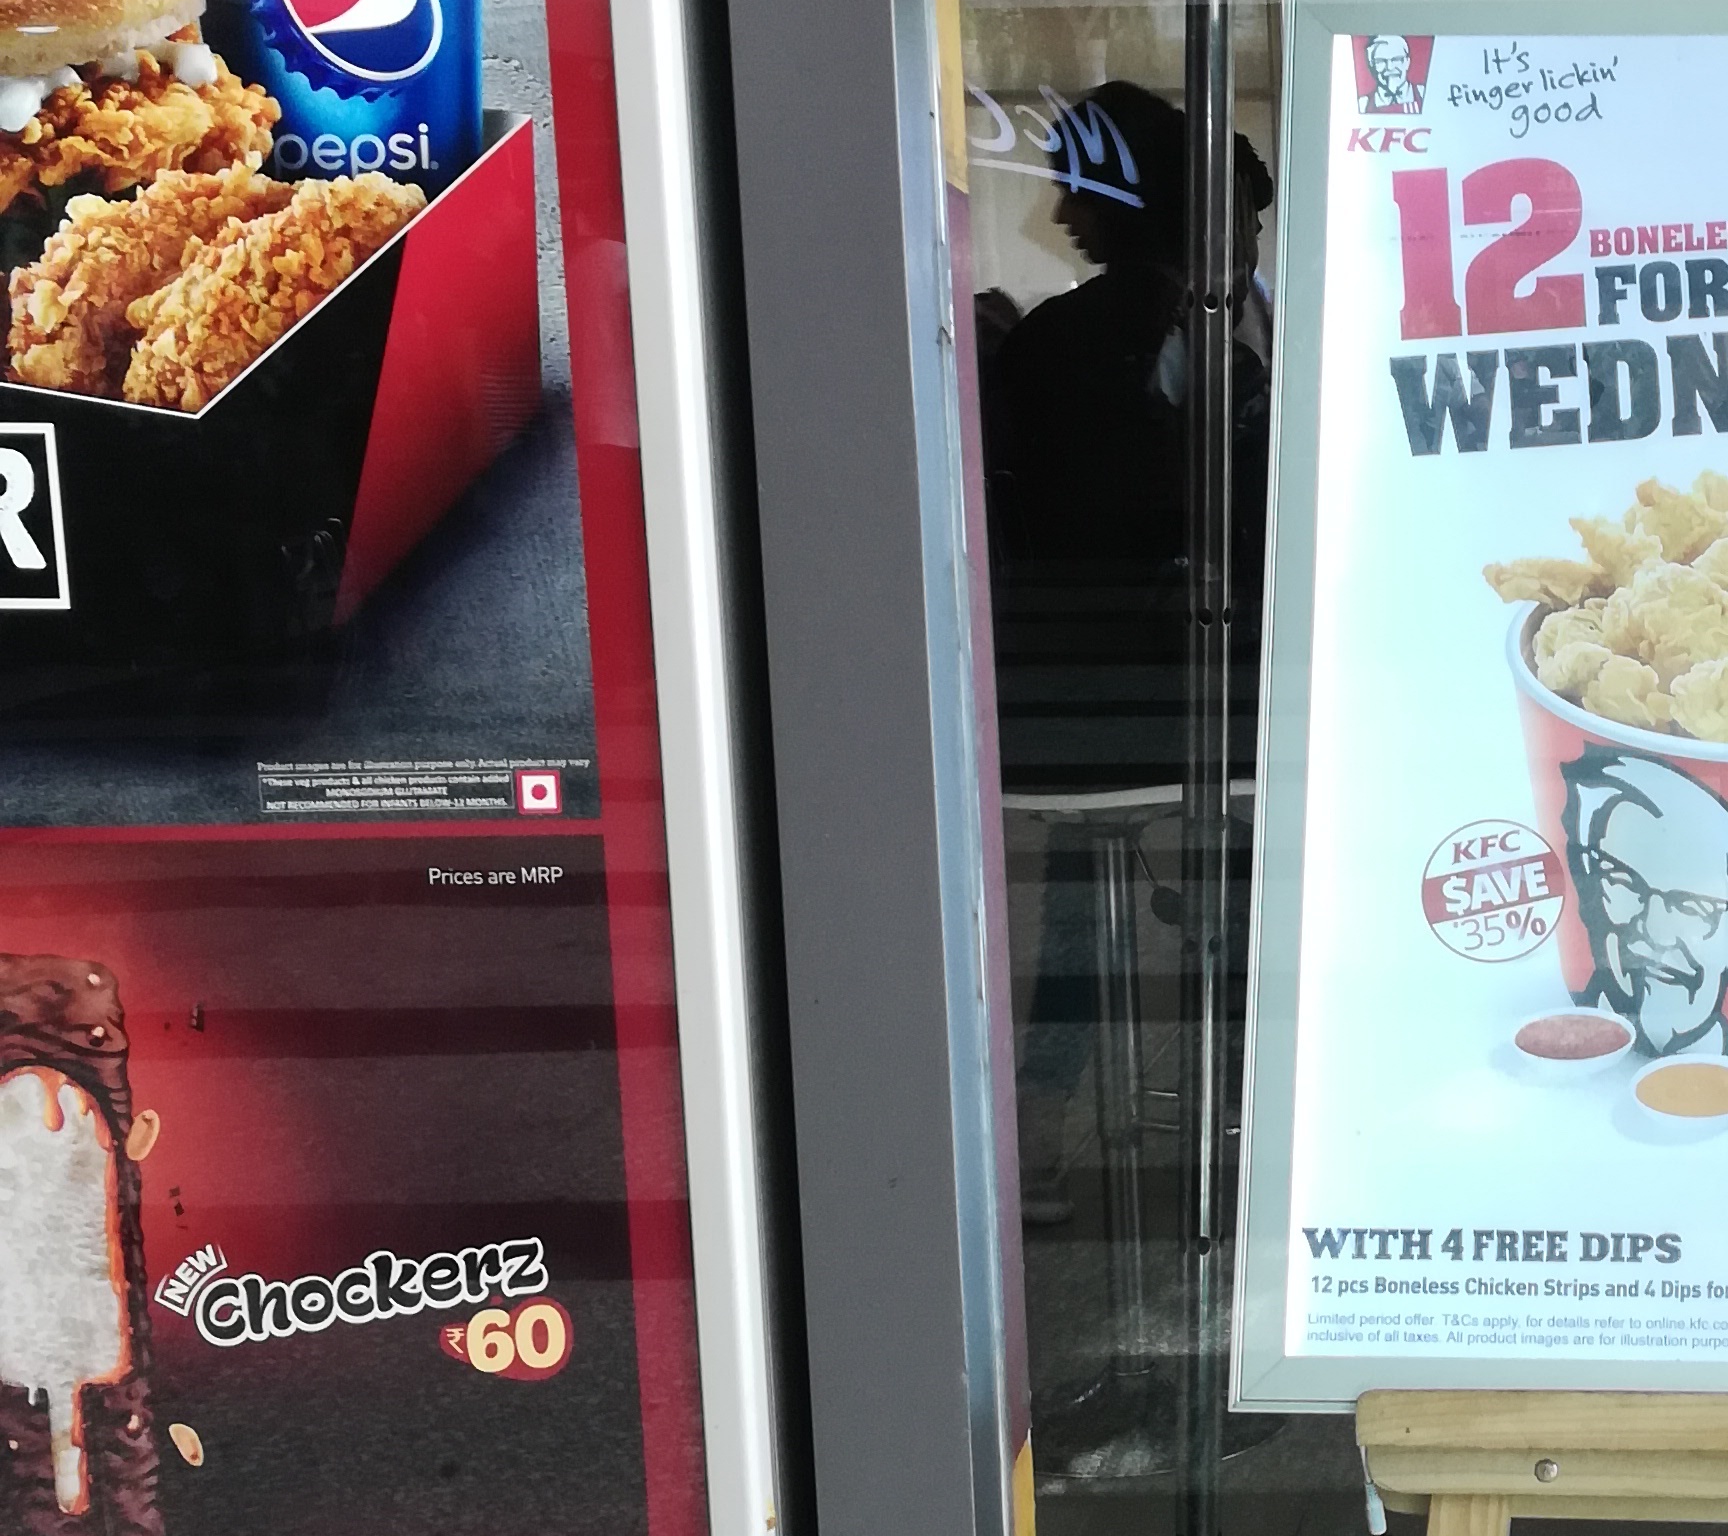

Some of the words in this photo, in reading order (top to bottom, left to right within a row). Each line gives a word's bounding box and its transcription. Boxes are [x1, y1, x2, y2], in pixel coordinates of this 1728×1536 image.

[1484, 41, 1529, 75] It's
[1447, 81, 1533, 110] finger
[1540, 56, 1619, 92] lickin'
[1510, 92, 1603, 138] good
[1347, 128, 1432, 153] KFC
[1392, 157, 1588, 341] 12
[1452, 830, 1520, 865] KFC
[428, 866, 483, 886] Prices
[488, 871, 516, 886] are
[520, 866, 563, 885] MRP
[1442, 861, 1549, 916] $AVE
[1302, 1227, 1433, 1261] WITH
[1440, 1228, 1464, 1261] 4
[1472, 1229, 1568, 1262] FREE
[1579, 1232, 1682, 1264] DIPS
[162, 1243, 222, 1305] NEW
[196, 1237, 548, 1347] Chockerz
[1311, 1275, 1333, 1294] 12
[1337, 1277, 1369, 1297] pcs
[1375, 1276, 1460, 1295] Boneless
[1464, 1276, 1540, 1296] Chicken
[1544, 1278, 1601, 1299] Strips
[1605, 1280, 1639, 1297] and
[1643, 1280, 1656, 1297] 4
[1661, 1280, 1702, 1301] Dips
[1307, 1330, 1362, 1343] inclusive
[1368, 1330, 1381, 1342] of
[1384, 1330, 1399, 1342] all
[1446, 1331, 1464, 1343] All
[1467, 1331, 1516, 1346] product
[1521, 1332, 1569, 1347] images
[1573, 1334, 1594, 1345] are
[1598, 1332, 1616, 1345] for
[1620, 1333, 1687, 1346] illustration
[1308, 1313, 1355, 1328] Limited
[1359, 1314, 1400, 1331] period
[1442, 1314, 1479, 1328] T&Cs
[1525, 1315, 1543, 1329] for
[1547, 1316, 1589, 1330] details
[1594, 1317, 1624, 1331] refer
[1629, 1318, 1641, 1331] to
